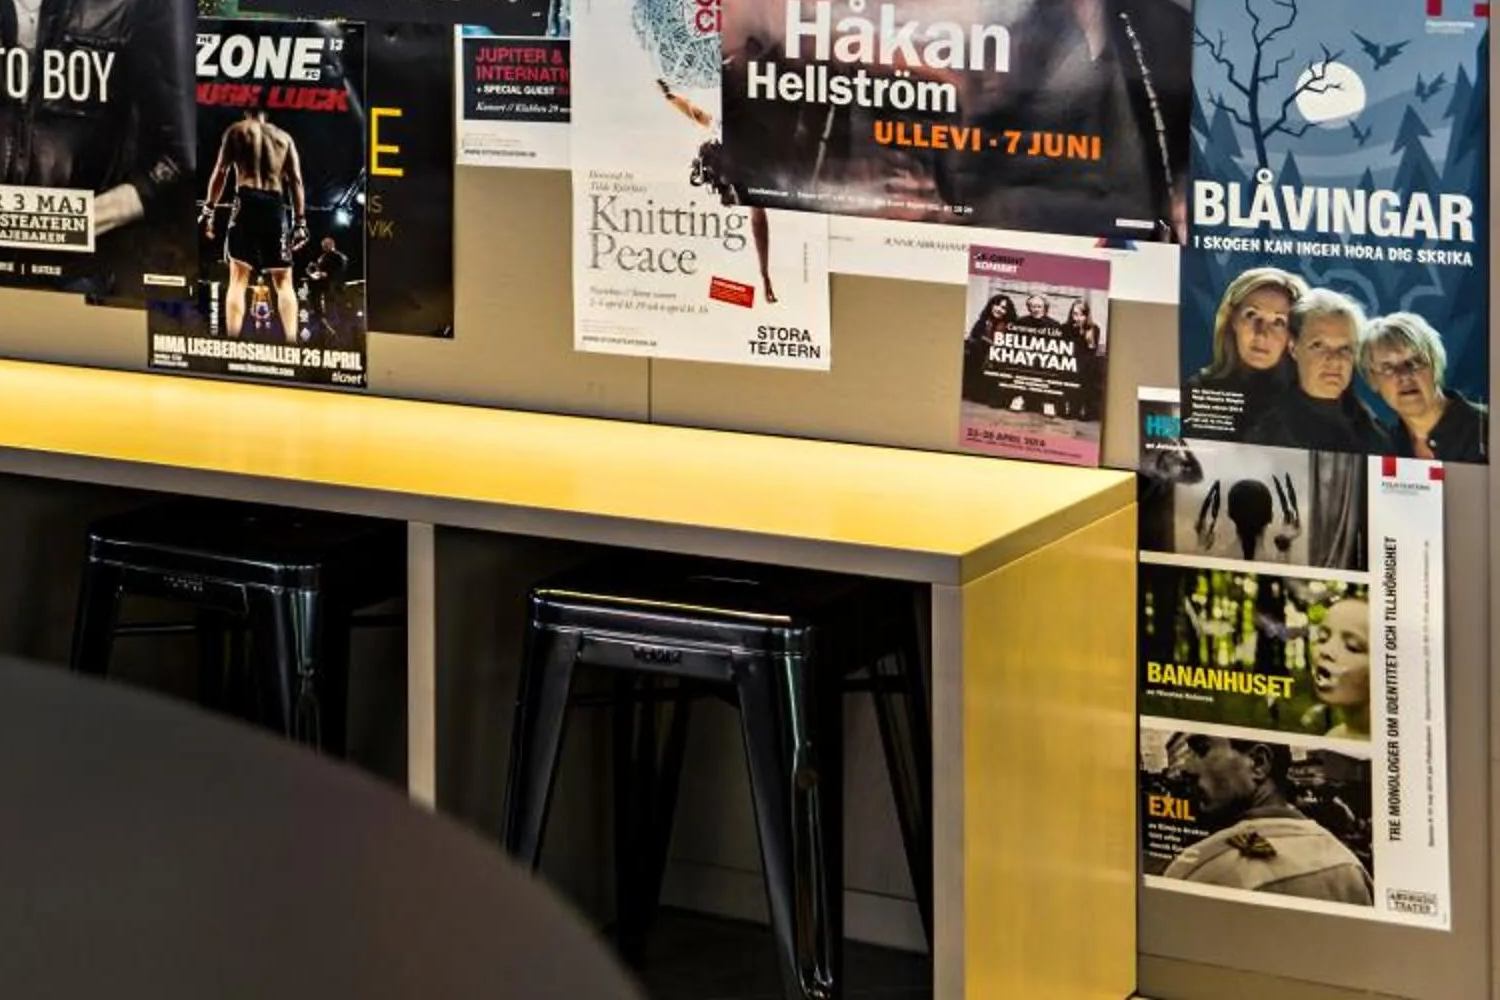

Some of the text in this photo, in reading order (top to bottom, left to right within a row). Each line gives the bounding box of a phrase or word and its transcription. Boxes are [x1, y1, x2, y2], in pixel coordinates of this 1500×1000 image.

[196, 33, 325, 81] ZONE
[475, 46, 547, 64] JUPITER
[43, 48, 117, 103] BOY
[483, 84, 556, 96] SPECIAL GUEST
[746, 60, 959, 115] Hellström
[266, 84, 350, 112] LUCK
[873, 120, 1102, 162] ULLEVI 7 JUNI
[12, 193, 26, 212] 3
[36, 194, 88, 216] MAJ
[1193, 167, 1476, 244] BLÅVINGAR
[587, 194, 749, 252] Knitting
[587, 231, 698, 276] Peace
[1202, 235, 1261, 255] SKOGEN
[1264, 238, 1295, 256] KAN
[1296, 240, 1342, 259] INGEN
[1343, 240, 1384, 261] HÖRA
[1386, 245, 1414, 263] DIG
[1415, 247, 1474, 267] SKRIKA
[756, 325, 813, 343] STORA
[993, 330, 1075, 357] BELLMAN
[152, 333, 187, 355] MMA
[187, 338, 302, 366] LISEBERGSHALLEN
[302, 348, 321, 366] 26
[322, 350, 364, 371] APRIL
[748, 340, 822, 360] TEATERN
[989, 345, 1078, 373] KHAYYAM
[1384, 623, 1398, 651] OCH
[1146, 660, 1296, 700] BANANHUSET
[1384, 654, 1400, 716] IDENTITET
[1386, 717, 1400, 737] OM
[1386, 740, 1401, 817] MONOLOGER
[1148, 794, 1197, 823] EXIL
[1388, 819, 1402, 843] TRE
